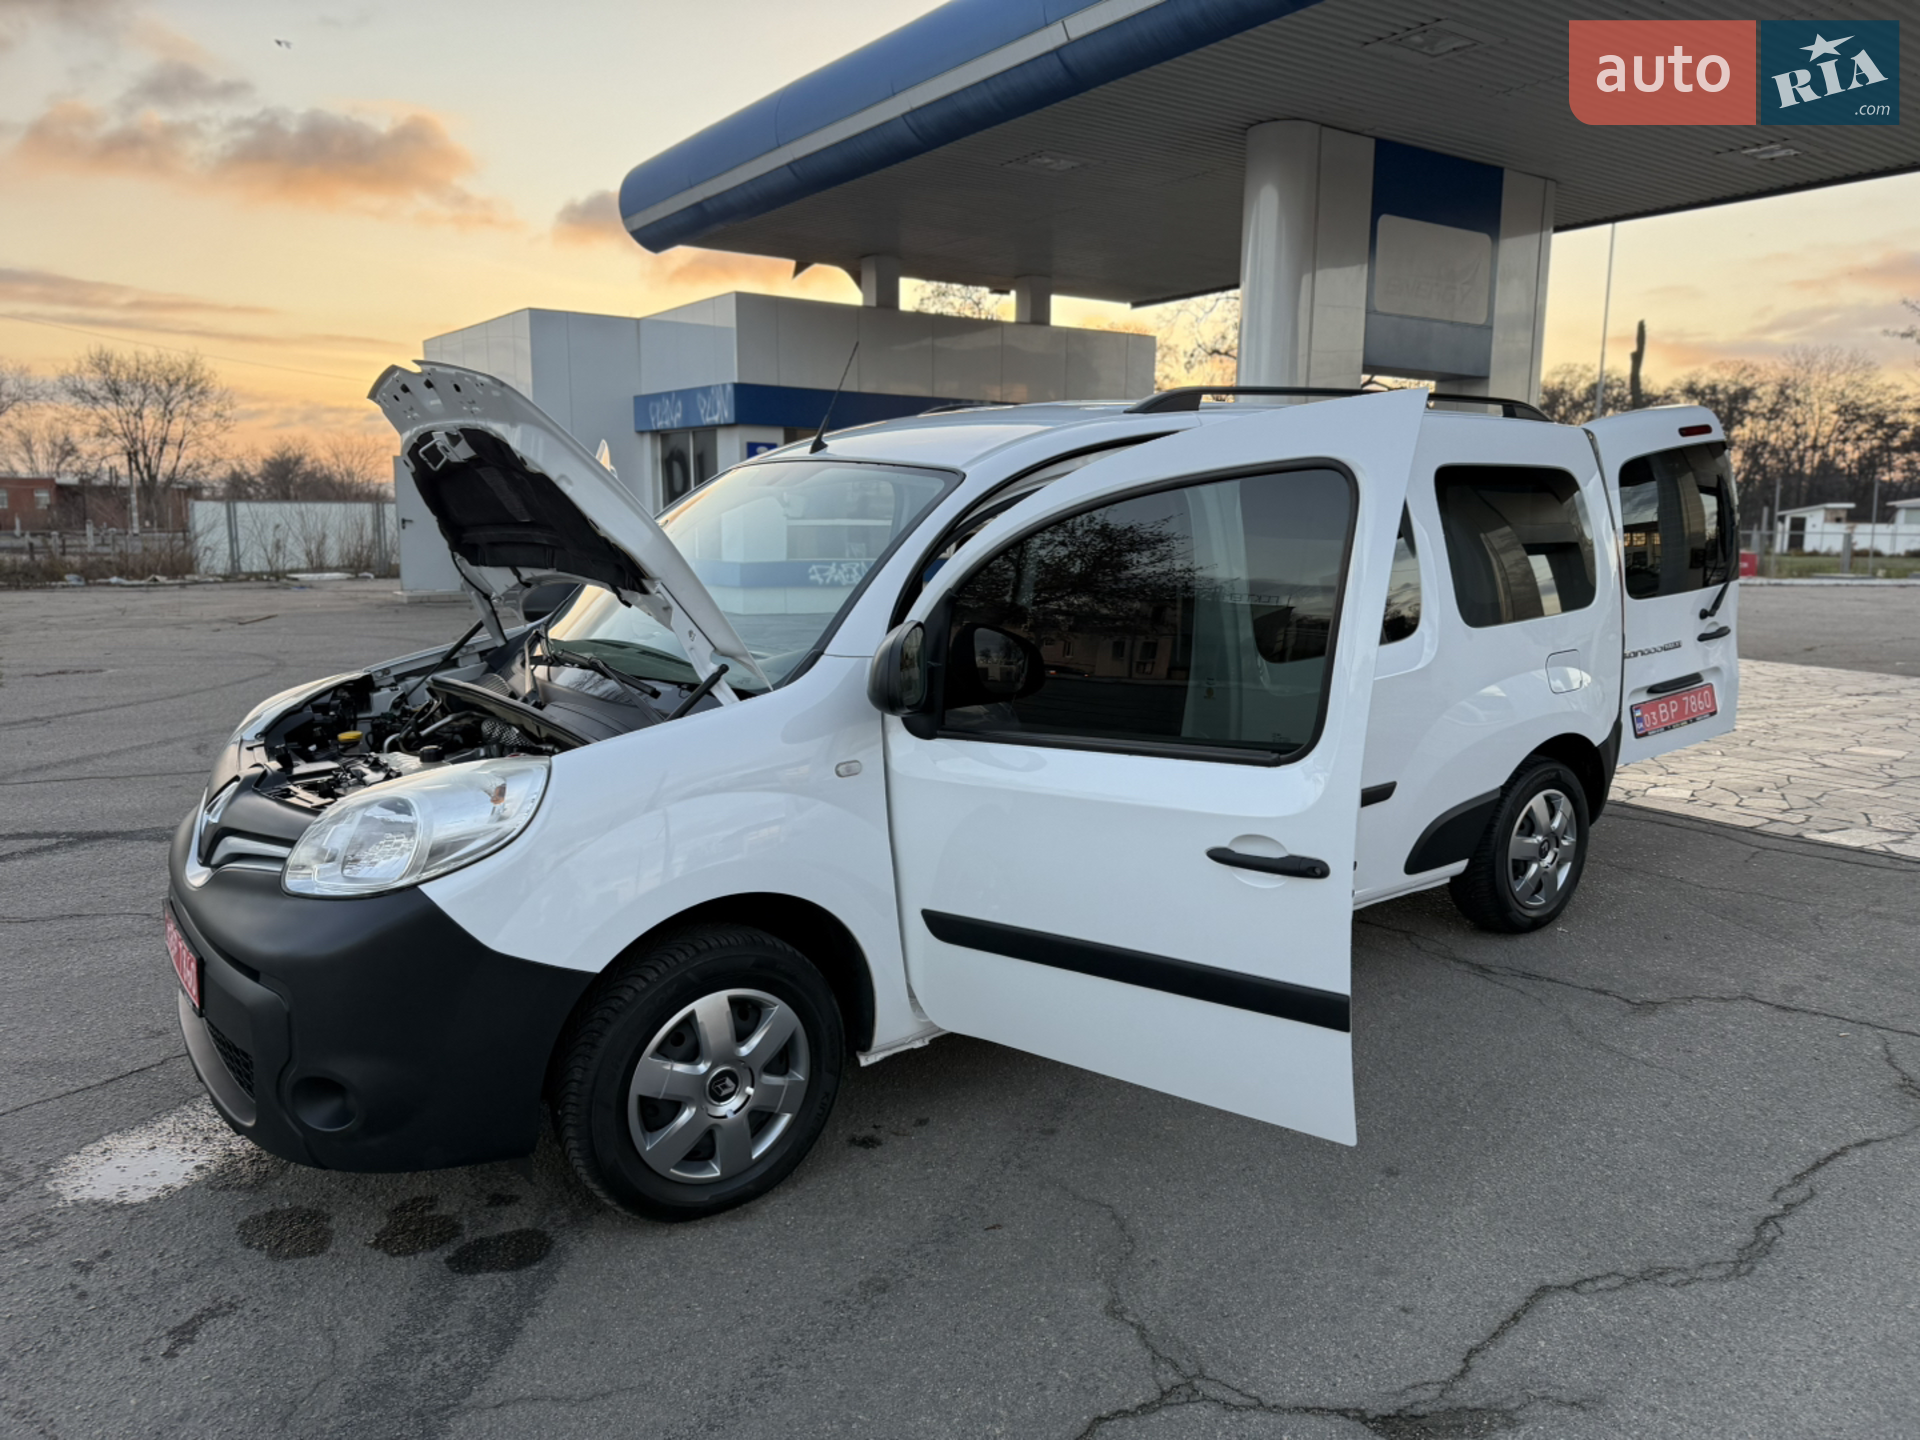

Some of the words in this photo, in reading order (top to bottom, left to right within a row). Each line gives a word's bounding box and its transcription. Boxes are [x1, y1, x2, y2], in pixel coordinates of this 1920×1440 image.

[1643, 711, 1658, 728] 03
[1658, 700, 1679, 723] BP
[1682, 691, 1711, 714] 7860
